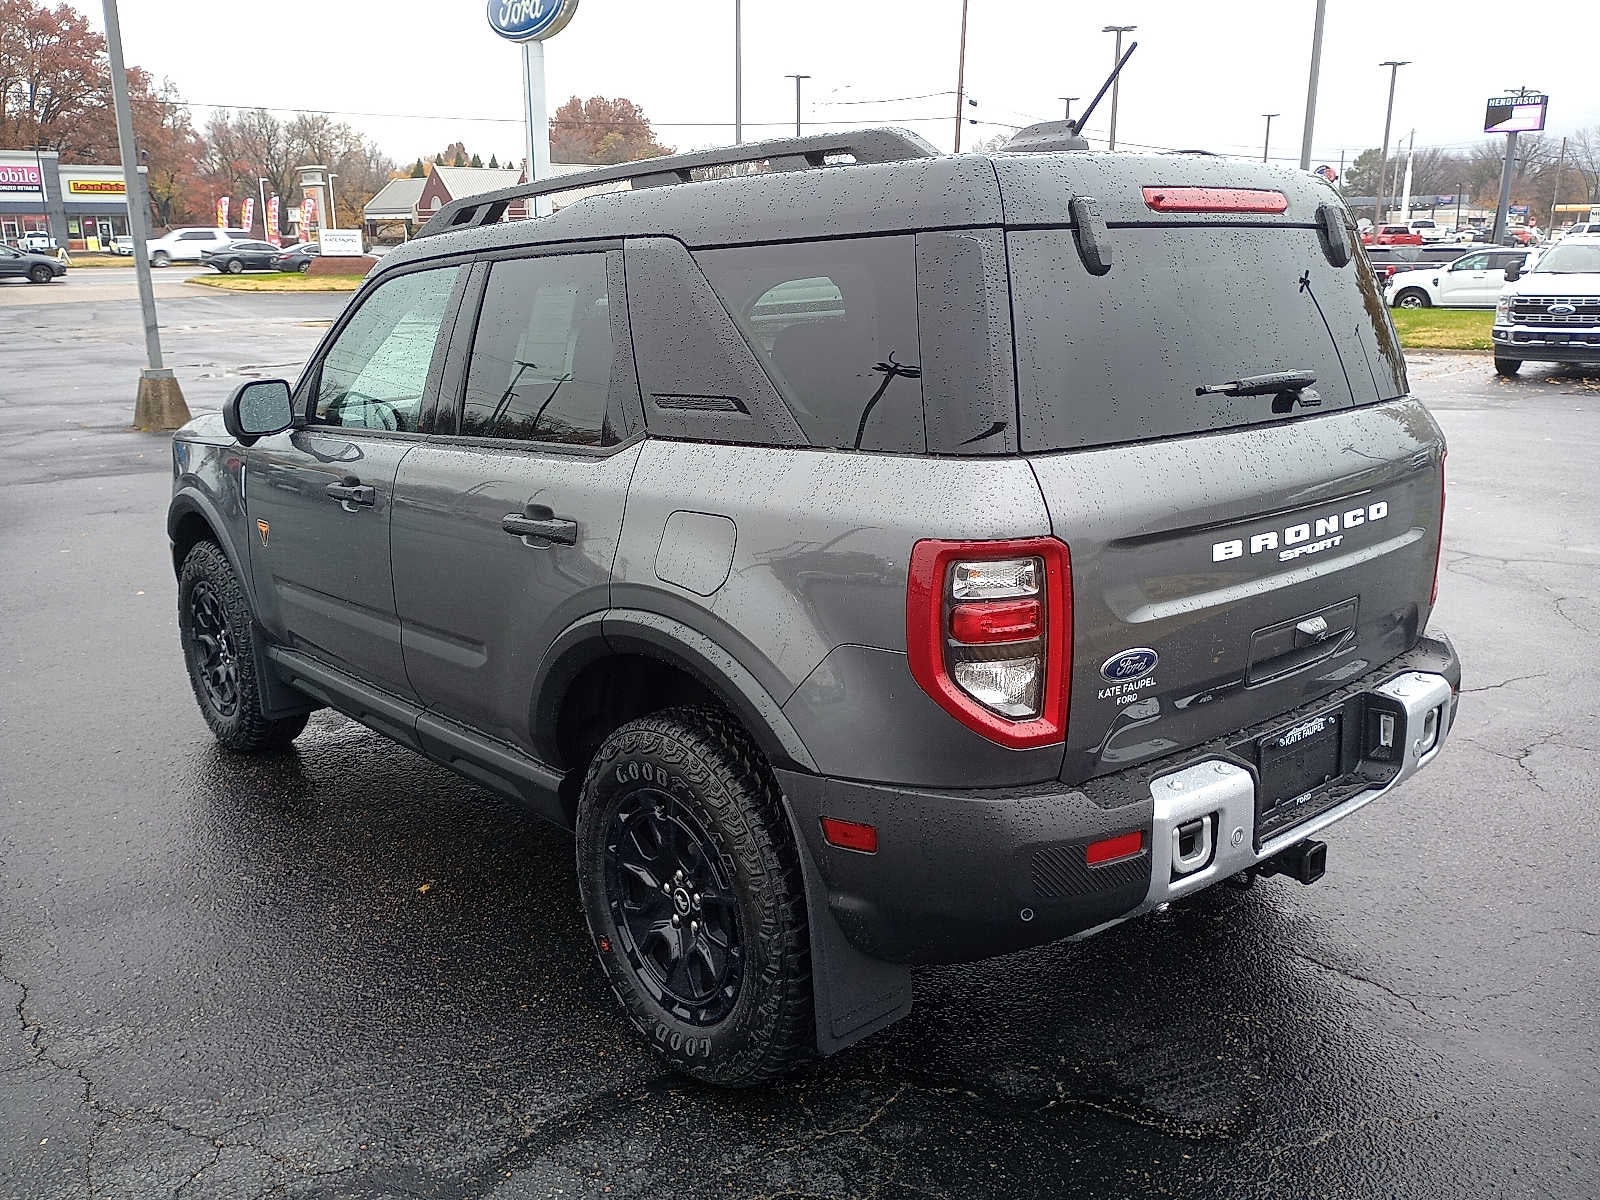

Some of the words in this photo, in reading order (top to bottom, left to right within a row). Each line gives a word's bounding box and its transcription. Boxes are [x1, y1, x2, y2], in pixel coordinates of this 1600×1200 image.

[498, 0, 544, 27] Ford
[1489, 96, 1541, 107] HENDERSON
[1212, 501, 1388, 562] BRONCO
[1278, 535, 1344, 562] SPORT
[1116, 655, 1148, 677] Ford
[1097, 685, 1122, 700] KATE
[1122, 676, 1157, 694] FAUPEL
[1116, 693, 1138, 706] FORD
[1285, 732, 1302, 747] KATE
[1302, 721, 1325, 739] FAUPEL
[1296, 792, 1312, 806] FORD
